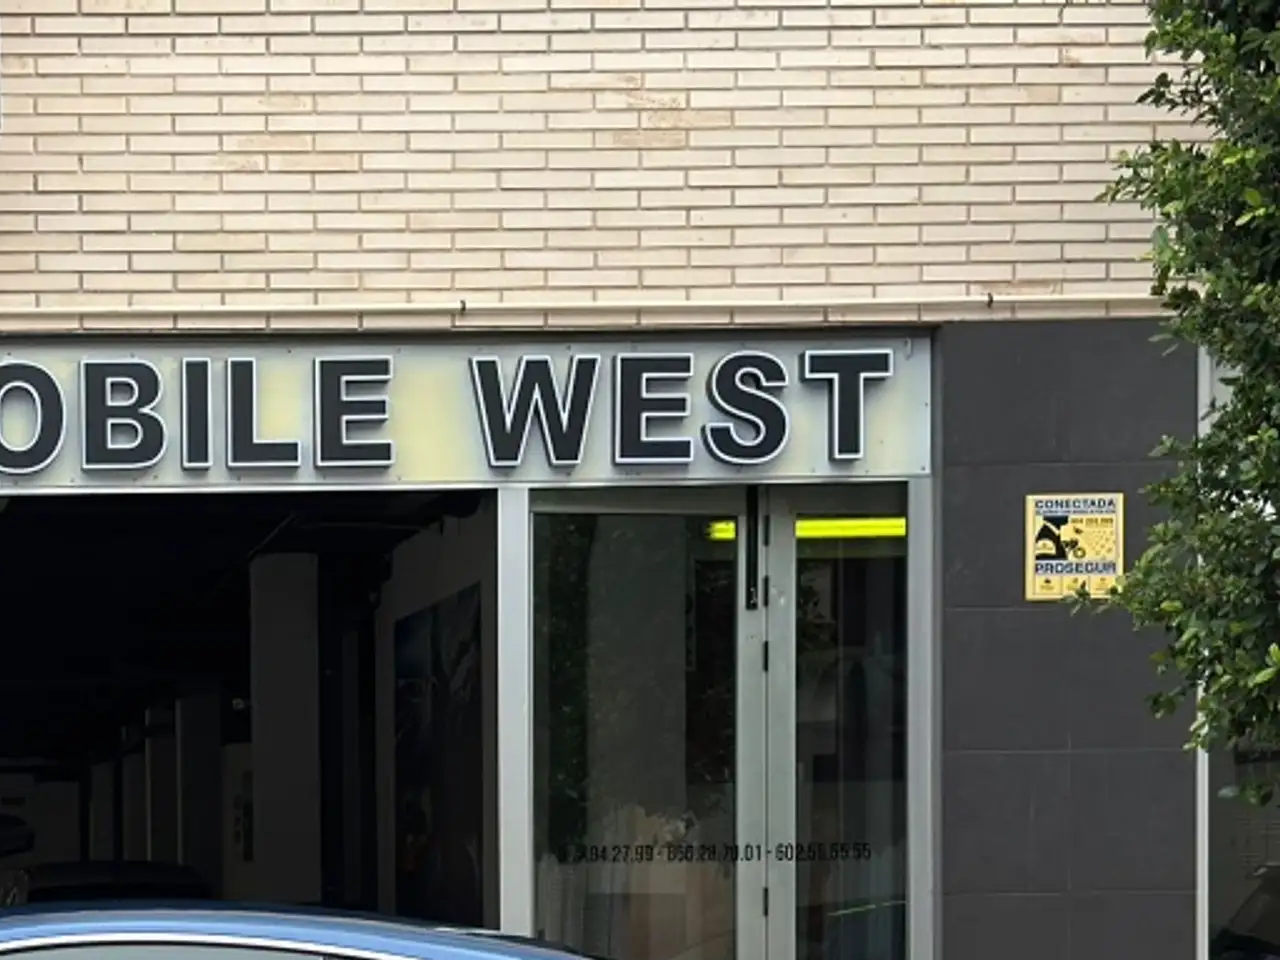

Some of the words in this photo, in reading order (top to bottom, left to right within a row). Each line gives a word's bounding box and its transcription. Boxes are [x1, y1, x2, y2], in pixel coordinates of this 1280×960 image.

[468, 349, 893, 467] WEST
[1035, 498, 1116, 509] CONECTADA
[1035, 562, 1116, 574] PROSEGUR
